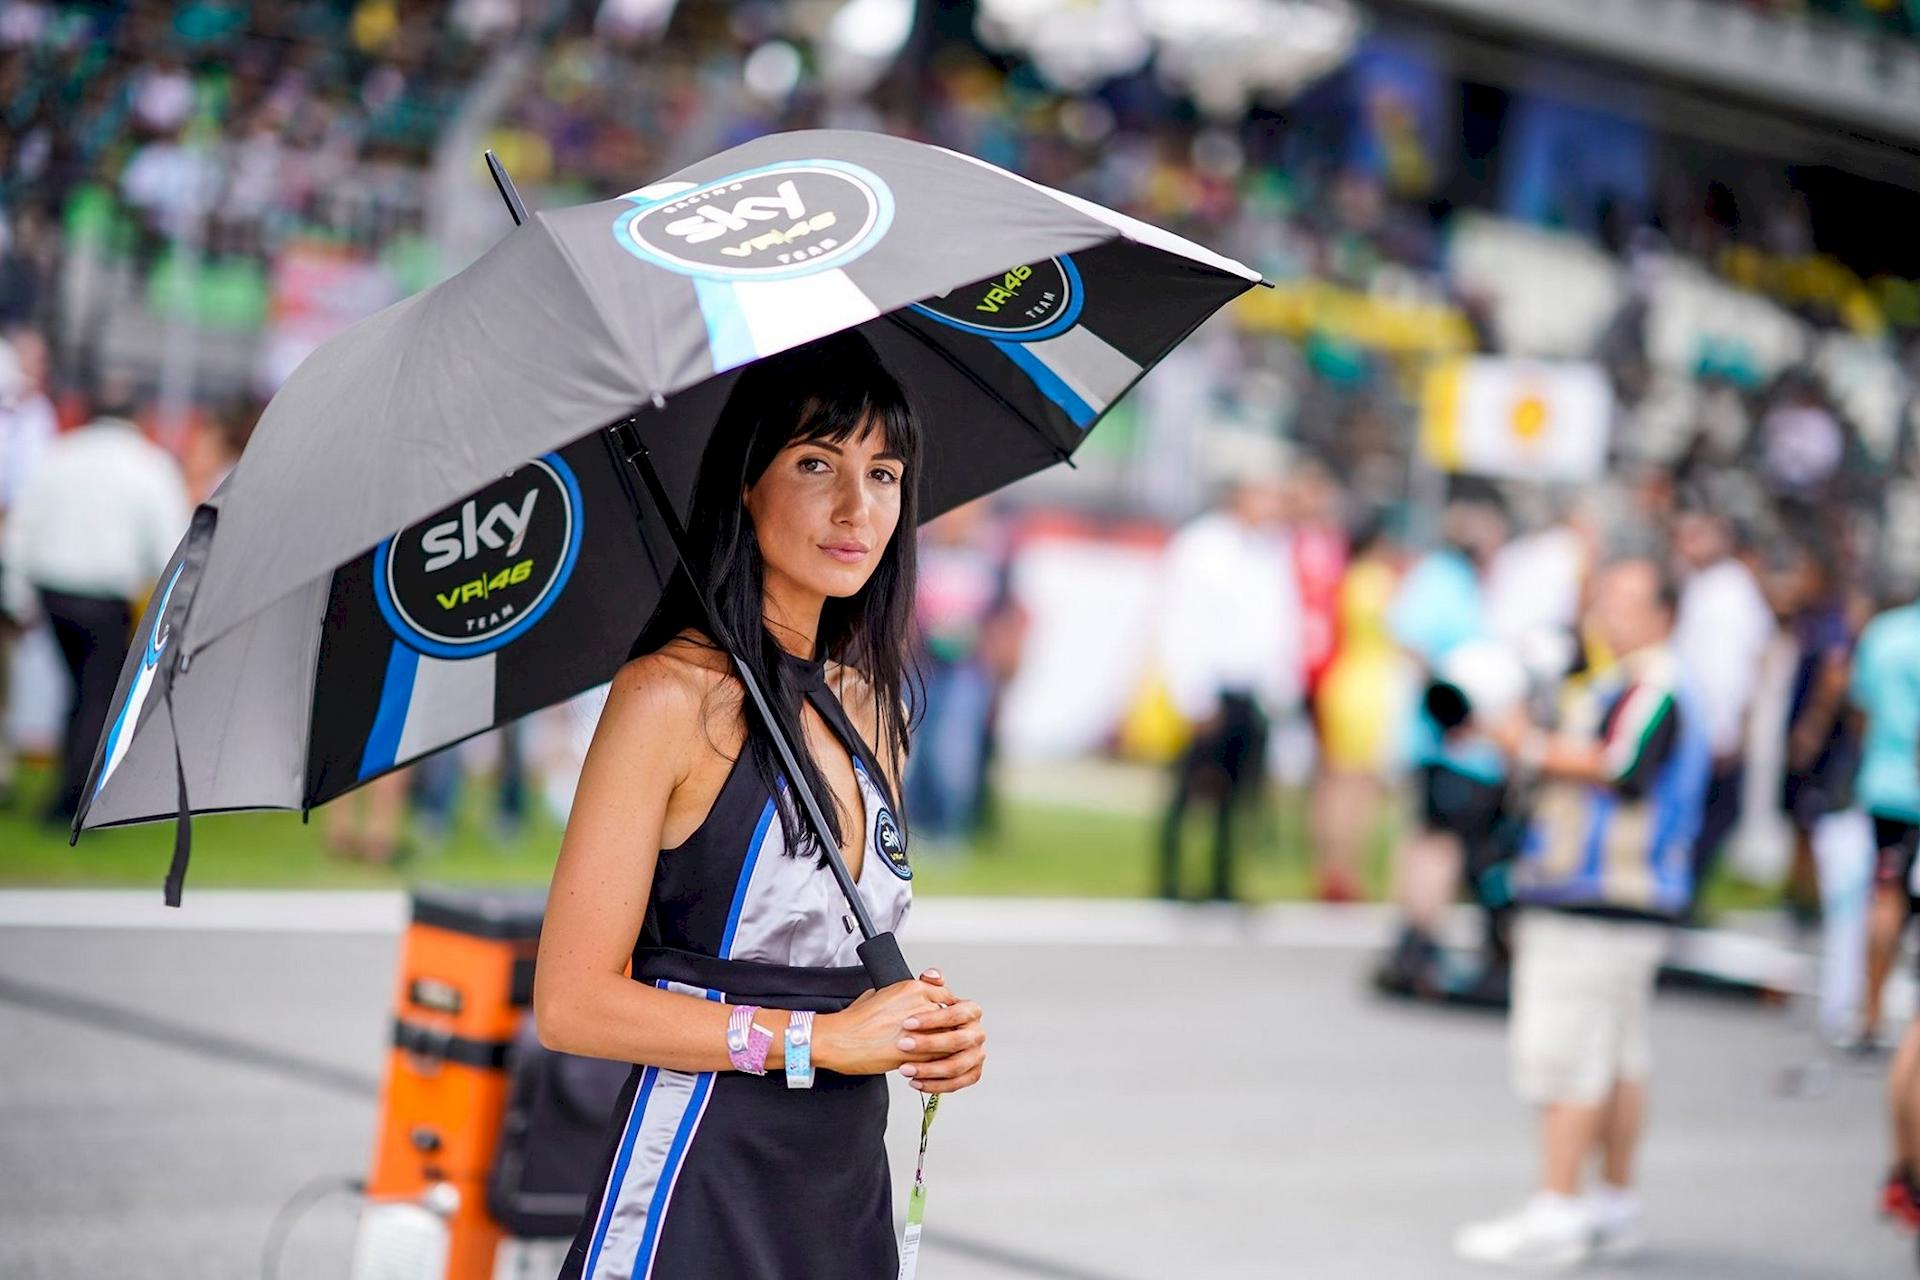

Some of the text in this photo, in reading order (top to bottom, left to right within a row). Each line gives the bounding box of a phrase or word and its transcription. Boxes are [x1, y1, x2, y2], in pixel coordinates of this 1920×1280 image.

[665, 180, 805, 243] sky
[1025, 291, 1056, 318] TEAM
[421, 488, 539, 573] sky
[466, 604, 514, 631] TEAM
